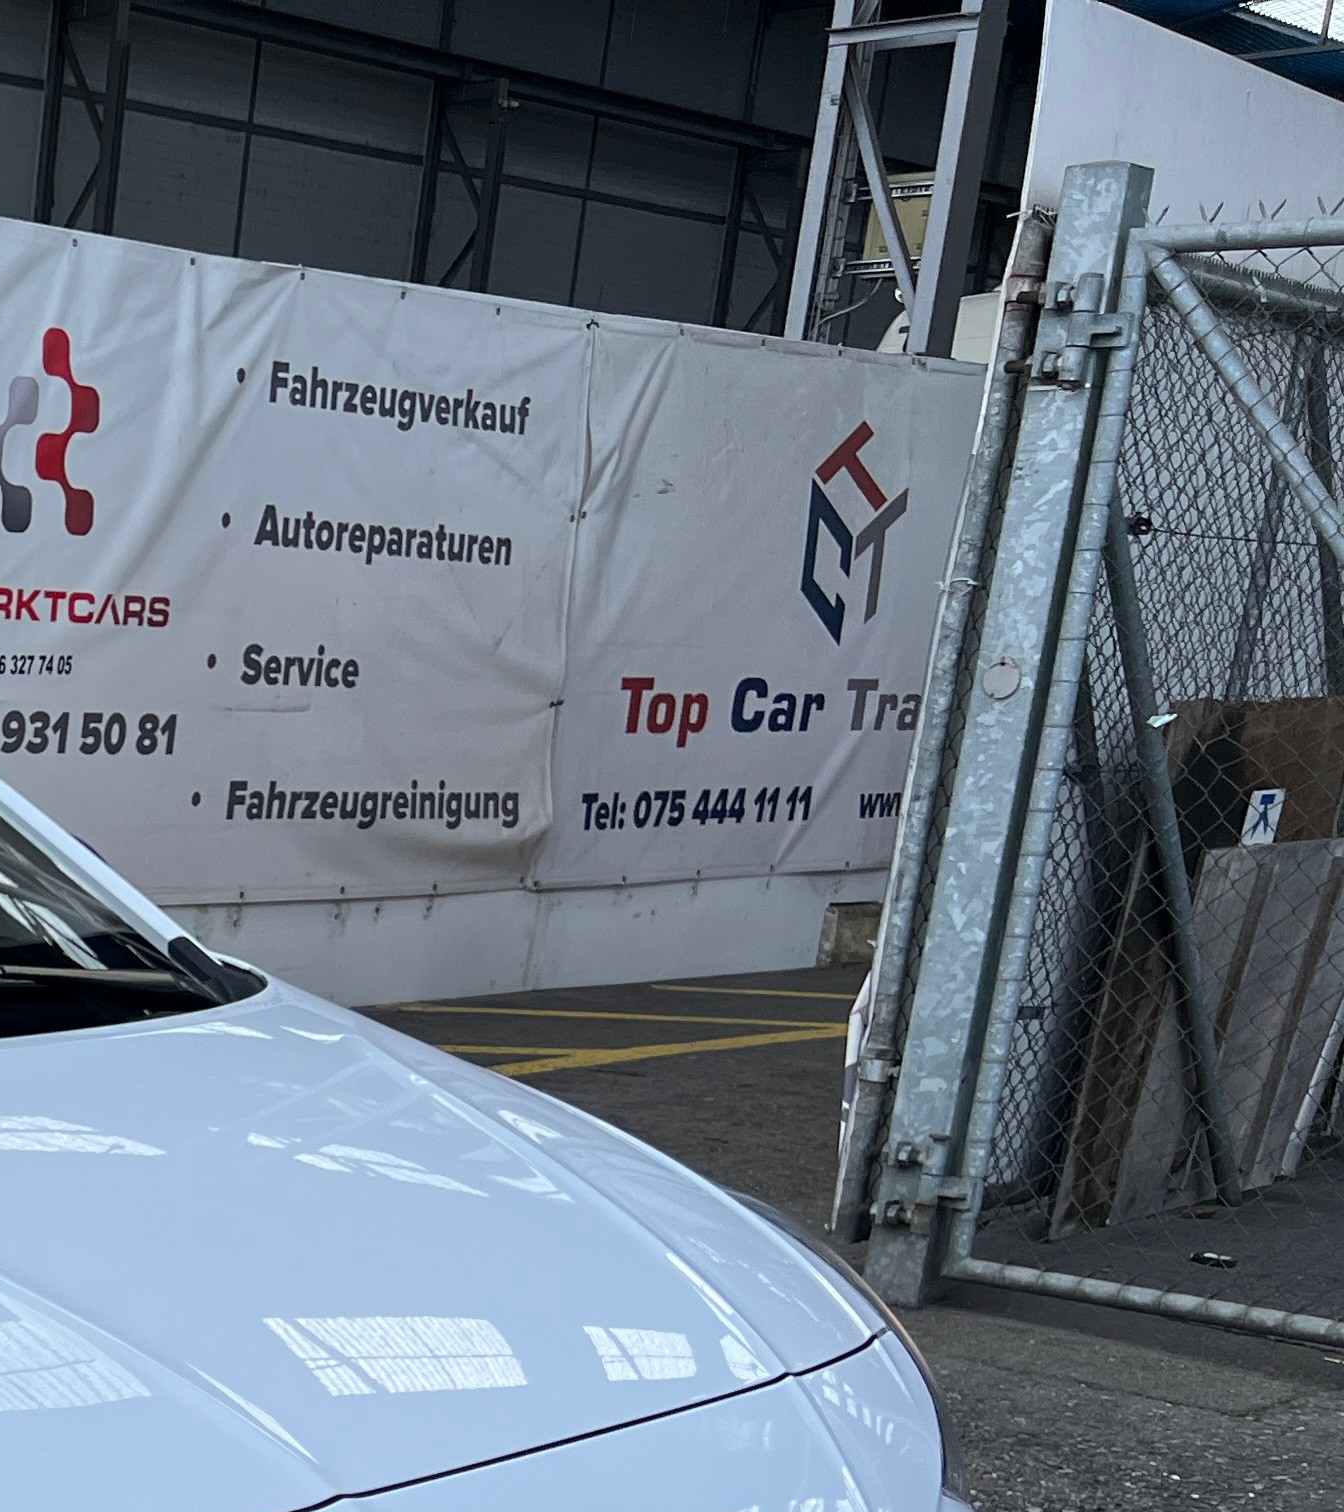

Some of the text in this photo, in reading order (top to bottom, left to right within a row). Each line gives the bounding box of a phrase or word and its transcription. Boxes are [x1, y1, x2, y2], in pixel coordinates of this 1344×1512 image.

[268, 360, 531, 437] Fahrzeugverkauf
[254, 504, 512, 567] Autoreparaturen
[10, 655, 35, 675] 327
[38, 655, 54, 675] 74
[57, 655, 73, 675] 05
[240, 643, 360, 690] Service
[0, 710, 71, 754] 931
[79, 712, 127, 755] 50
[136, 713, 178, 756] 81
[620, 677, 923, 748] Top Car Tra
[225, 779, 521, 830] Fahrzeugreinigung
[582, 792, 627, 831] Tel:
[633, 790, 687, 829] 075
[692, 788, 747, 825] 444
[754, 787, 781, 823] 11
[786, 786, 813, 821] 11
